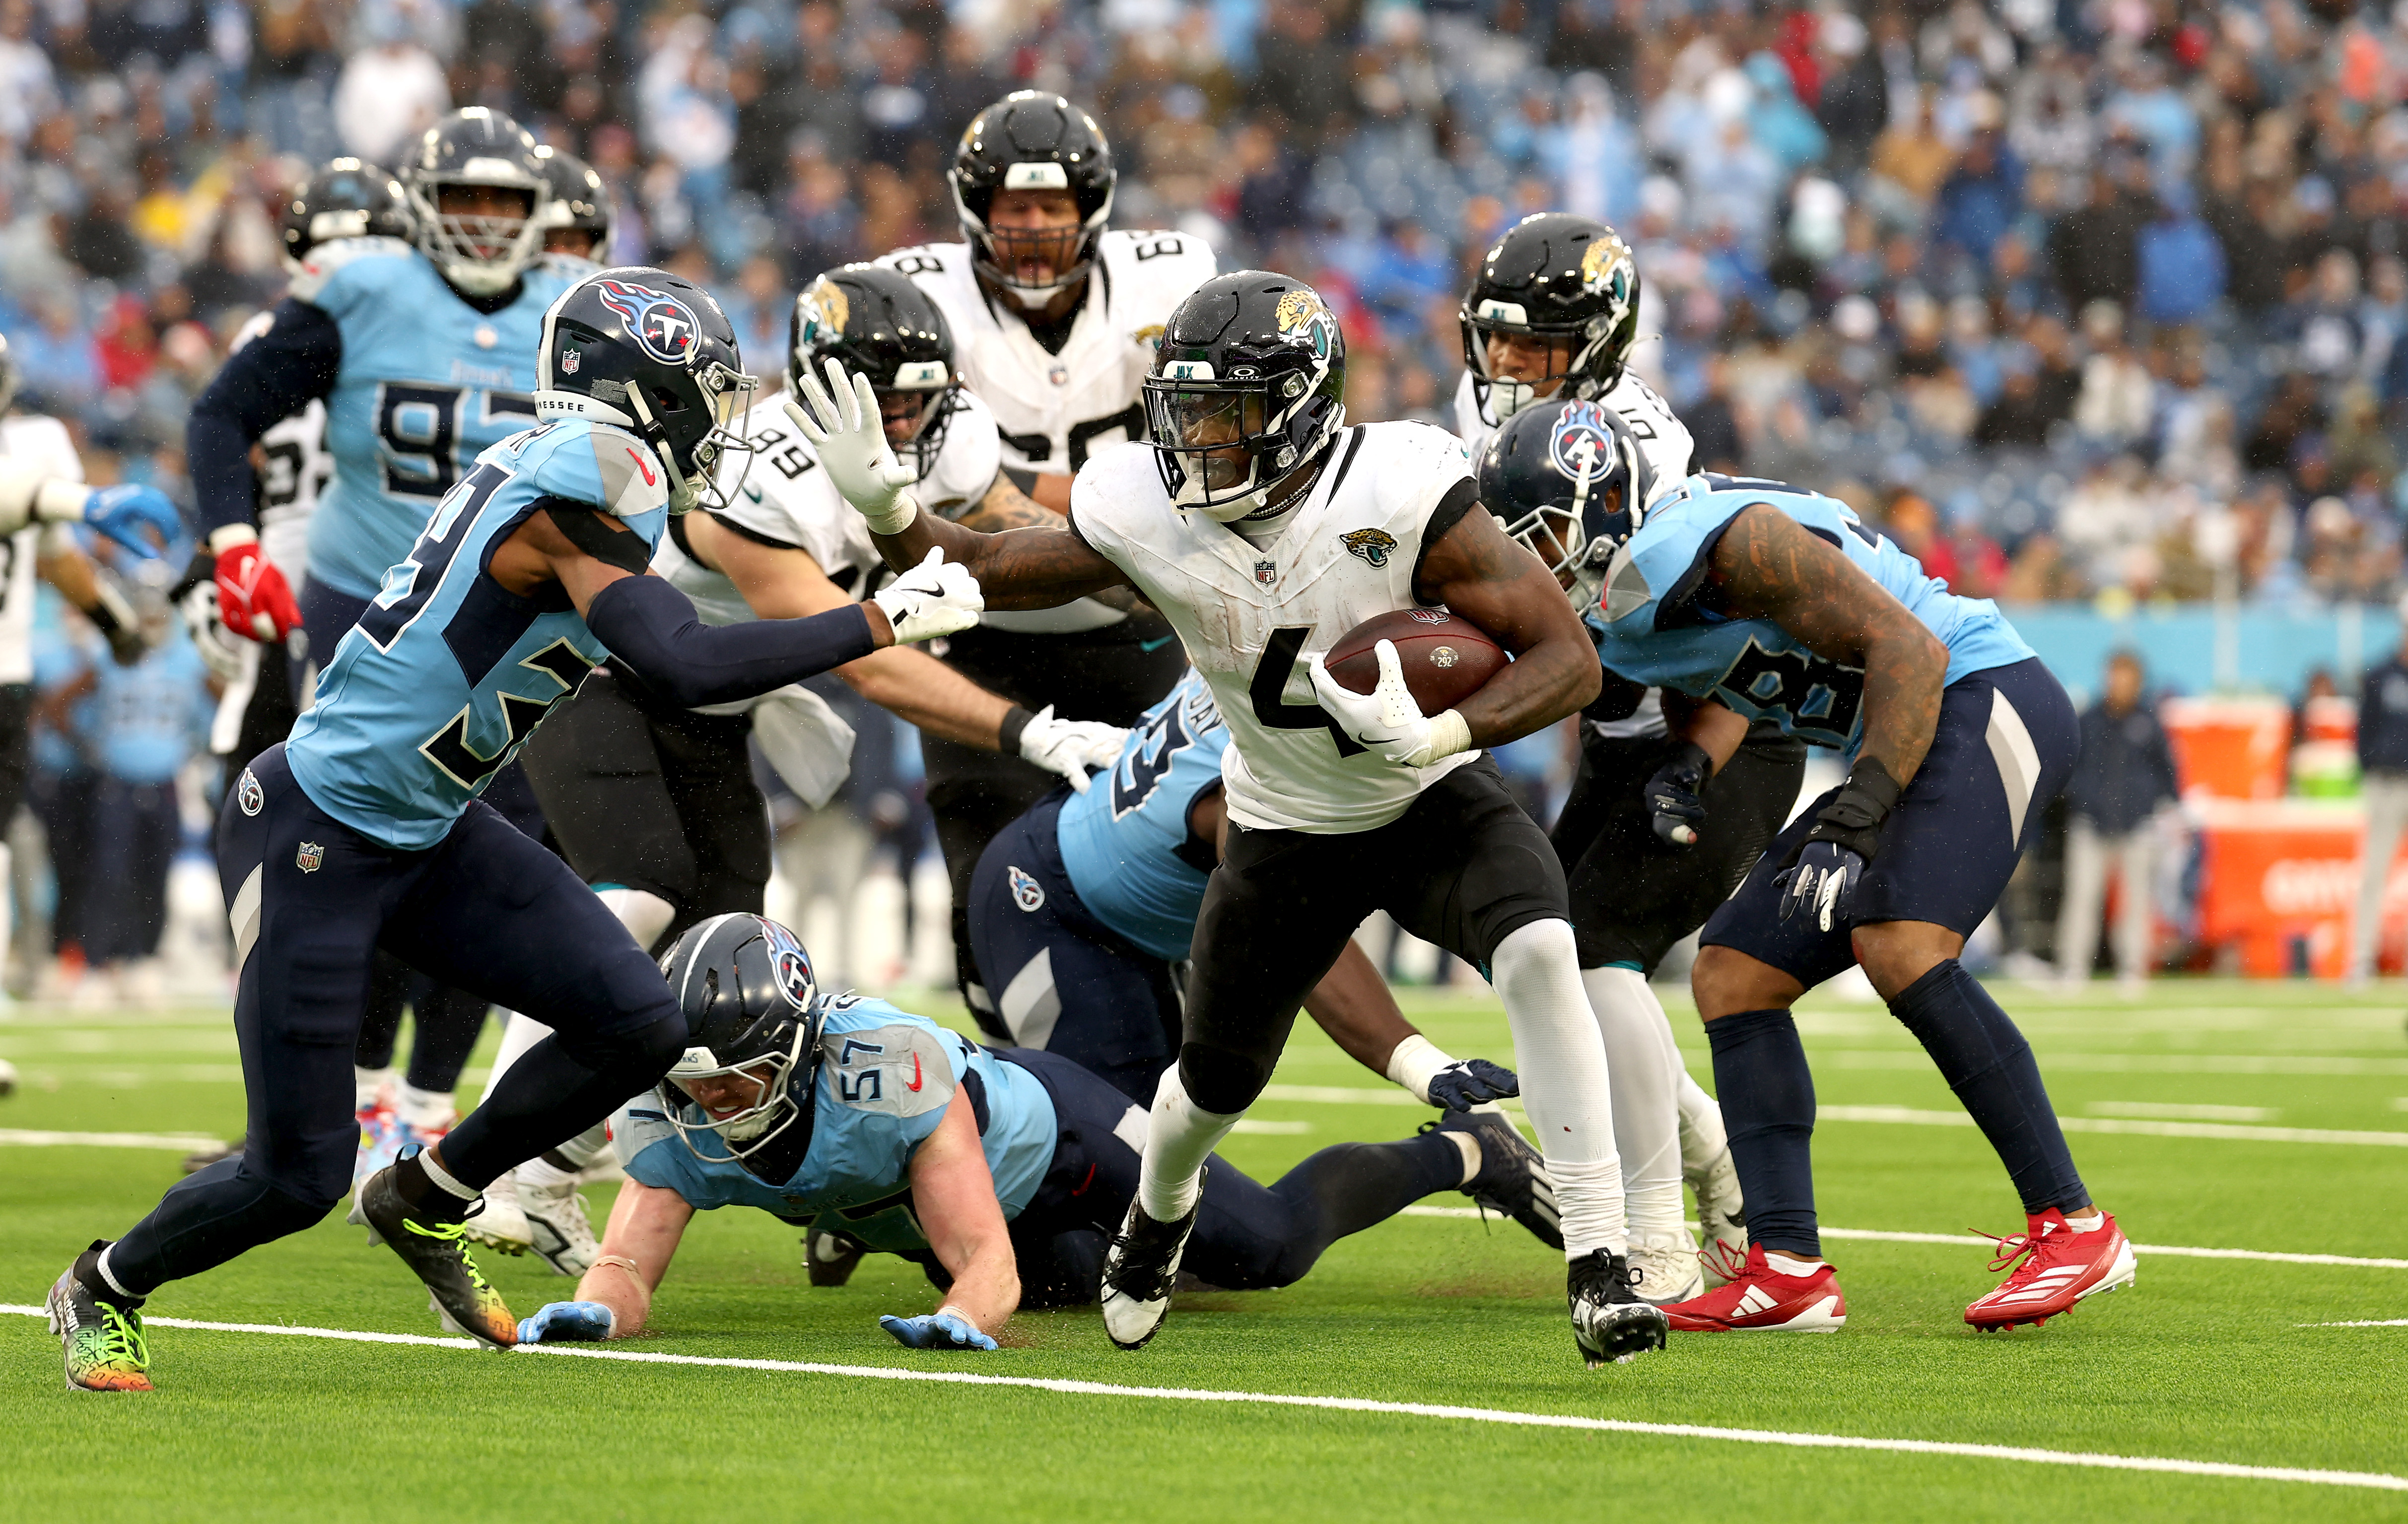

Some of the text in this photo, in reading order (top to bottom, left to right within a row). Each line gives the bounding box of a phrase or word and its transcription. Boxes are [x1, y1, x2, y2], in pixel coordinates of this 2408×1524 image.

[564, 360, 576, 371] NFL
[1173, 365, 1194, 379] JAX
[744, 428, 815, 479] 89
[1258, 571, 1274, 582] NFL
[1412, 610, 1445, 620] NFL
[1438, 657, 1452, 667] 292
[1249, 622, 1371, 758] 4
[300, 854, 317, 867] NFL
[840, 1037, 886, 1103] 57
